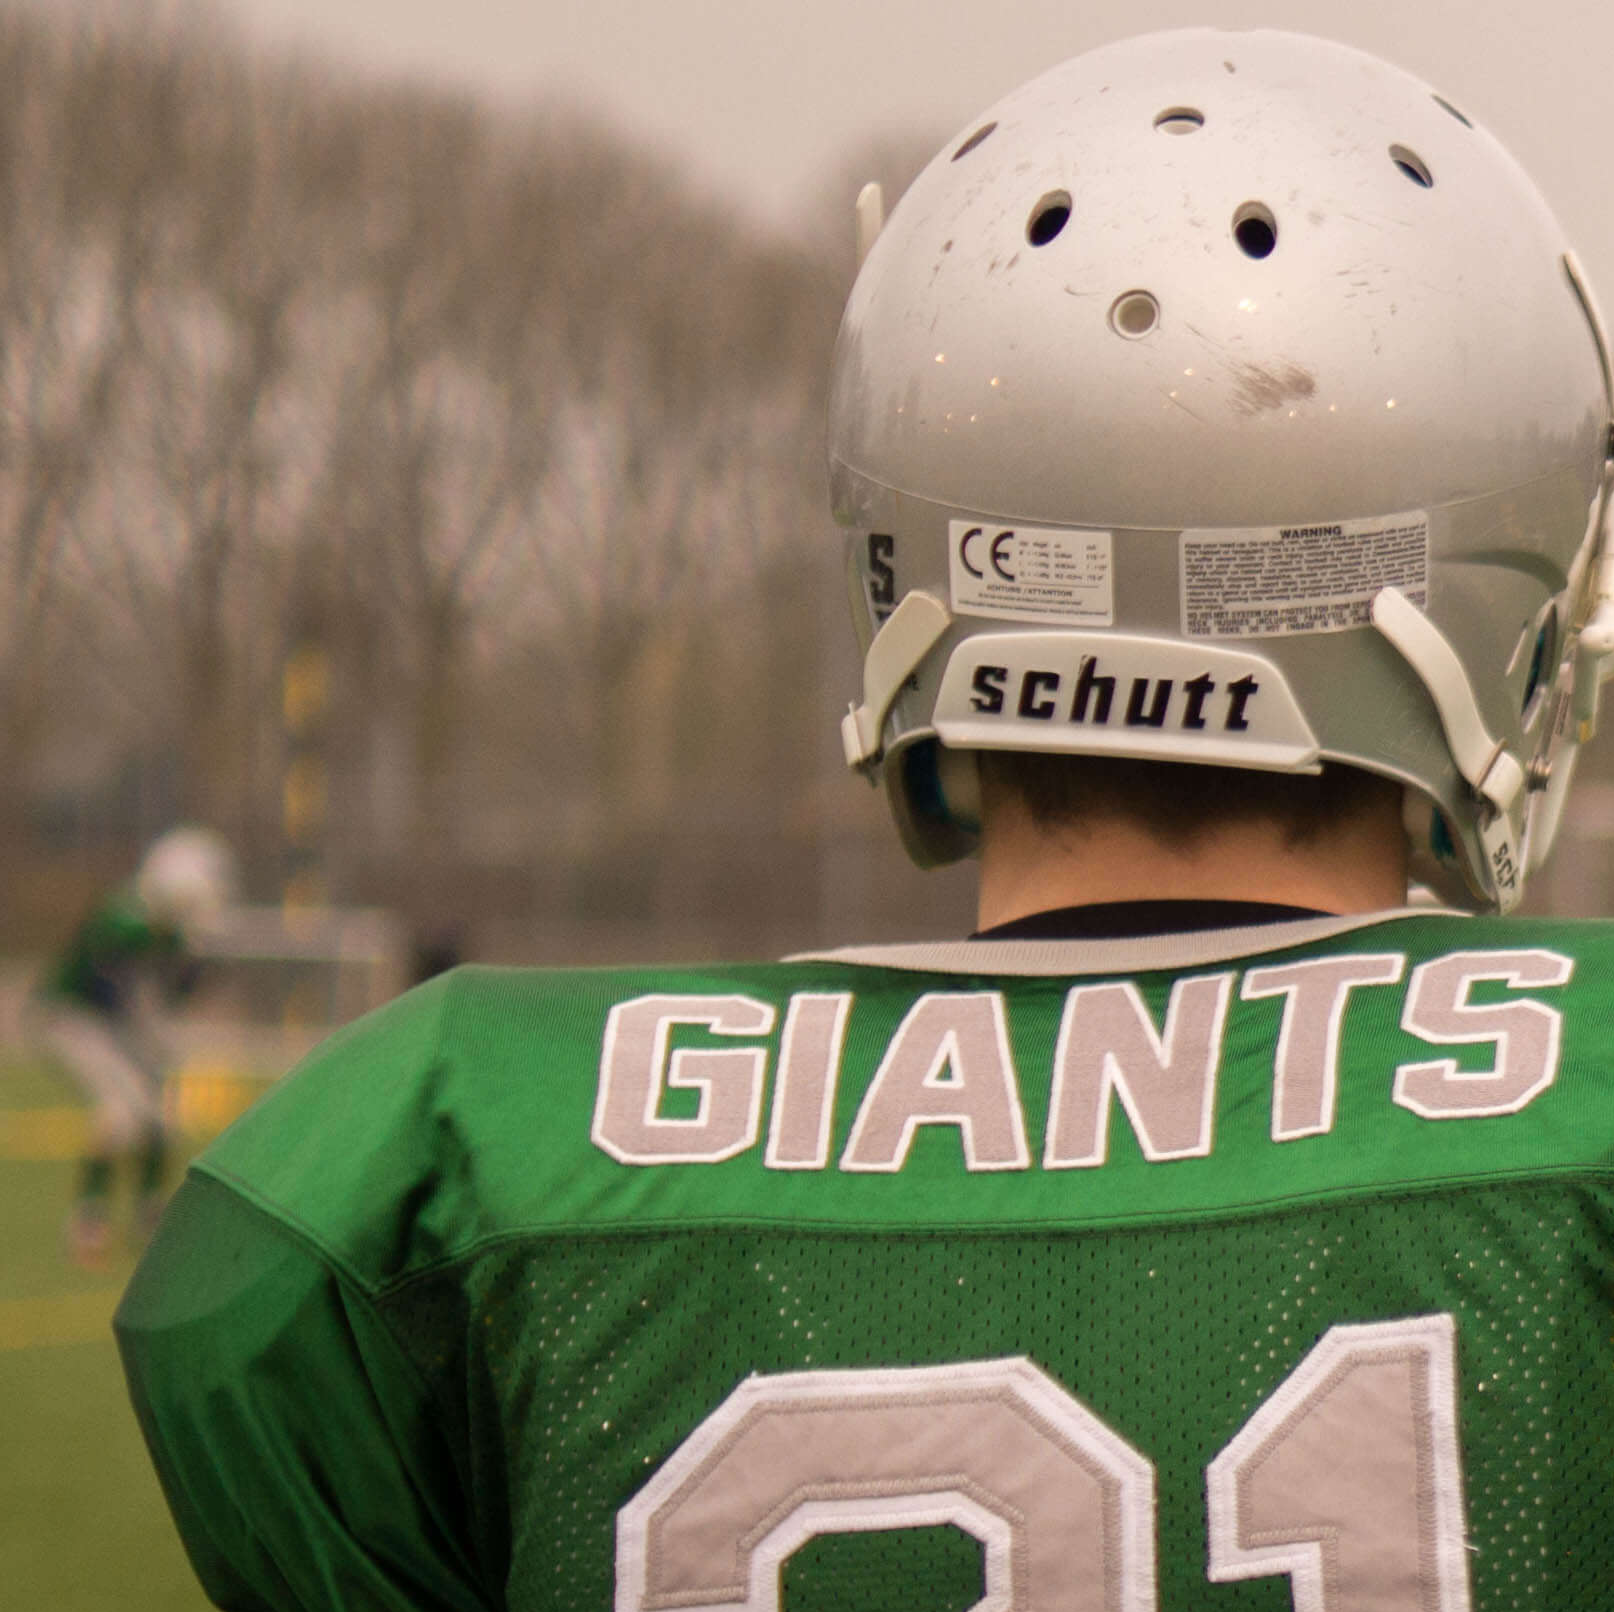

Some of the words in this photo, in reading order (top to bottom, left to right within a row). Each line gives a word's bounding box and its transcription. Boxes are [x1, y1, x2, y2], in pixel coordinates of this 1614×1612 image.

[959, 527, 1016, 583] CE
[1280, 525, 1342, 539] WARNING
[970, 653, 1260, 731] schutt
[590, 949, 1575, 1171] GIANTS
